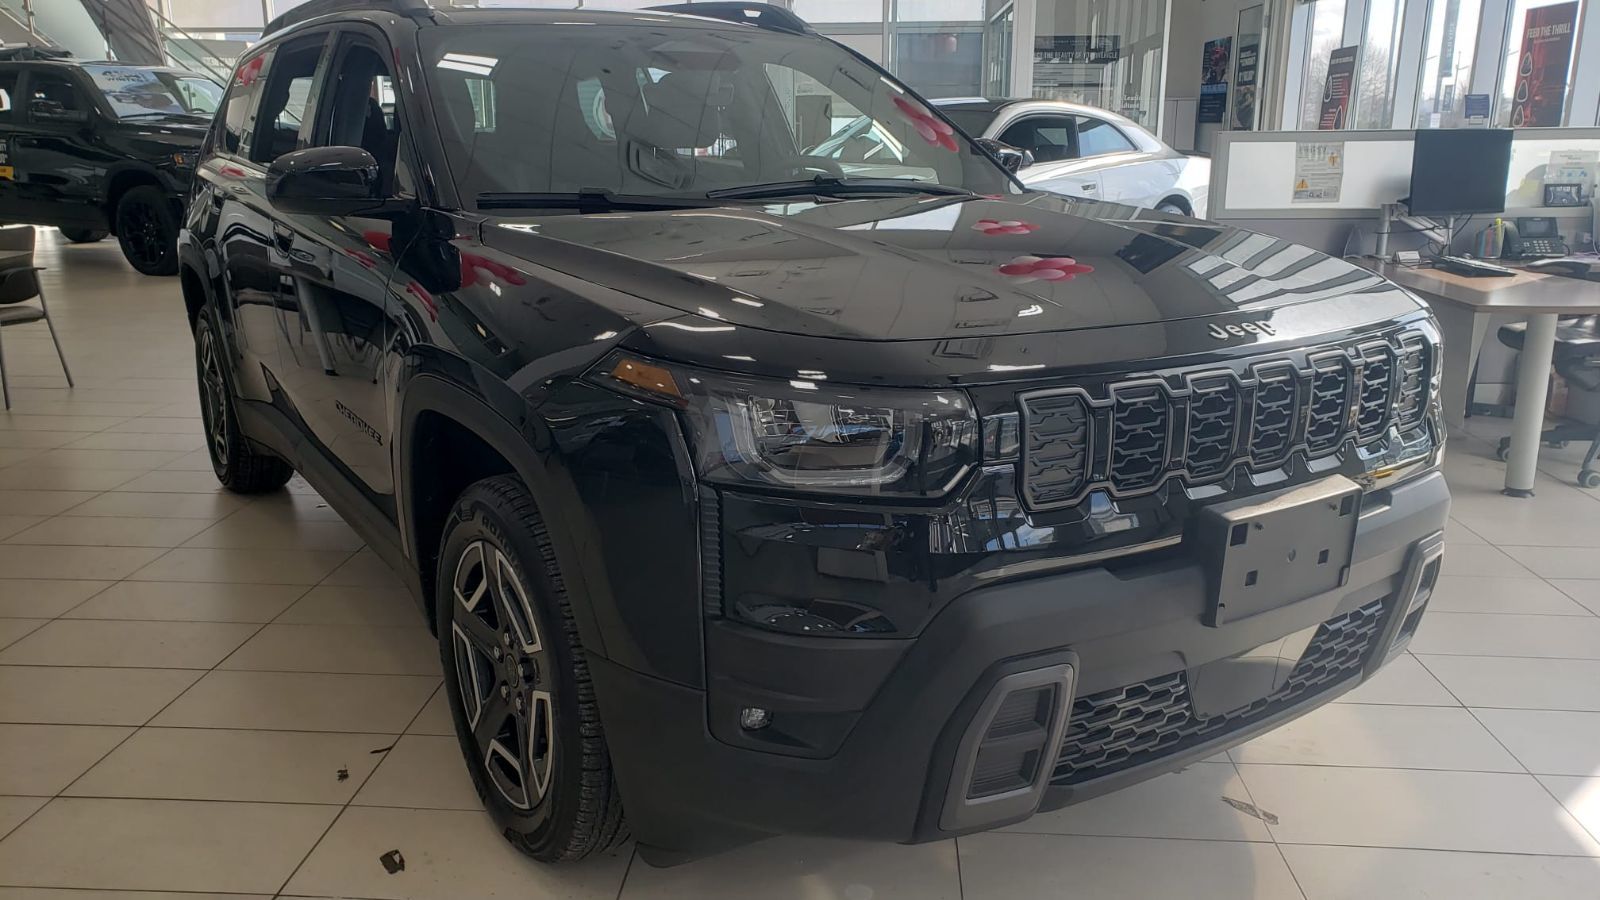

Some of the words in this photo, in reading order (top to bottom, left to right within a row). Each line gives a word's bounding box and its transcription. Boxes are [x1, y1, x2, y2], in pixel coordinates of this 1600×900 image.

[1527, 27, 1540, 39] FEED
[1540, 25, 1552, 37] THE
[1552, 22, 1571, 36] THRILL
[1207, 320, 1277, 341] Jeep
[335, 399, 384, 447] CHEROKEE
